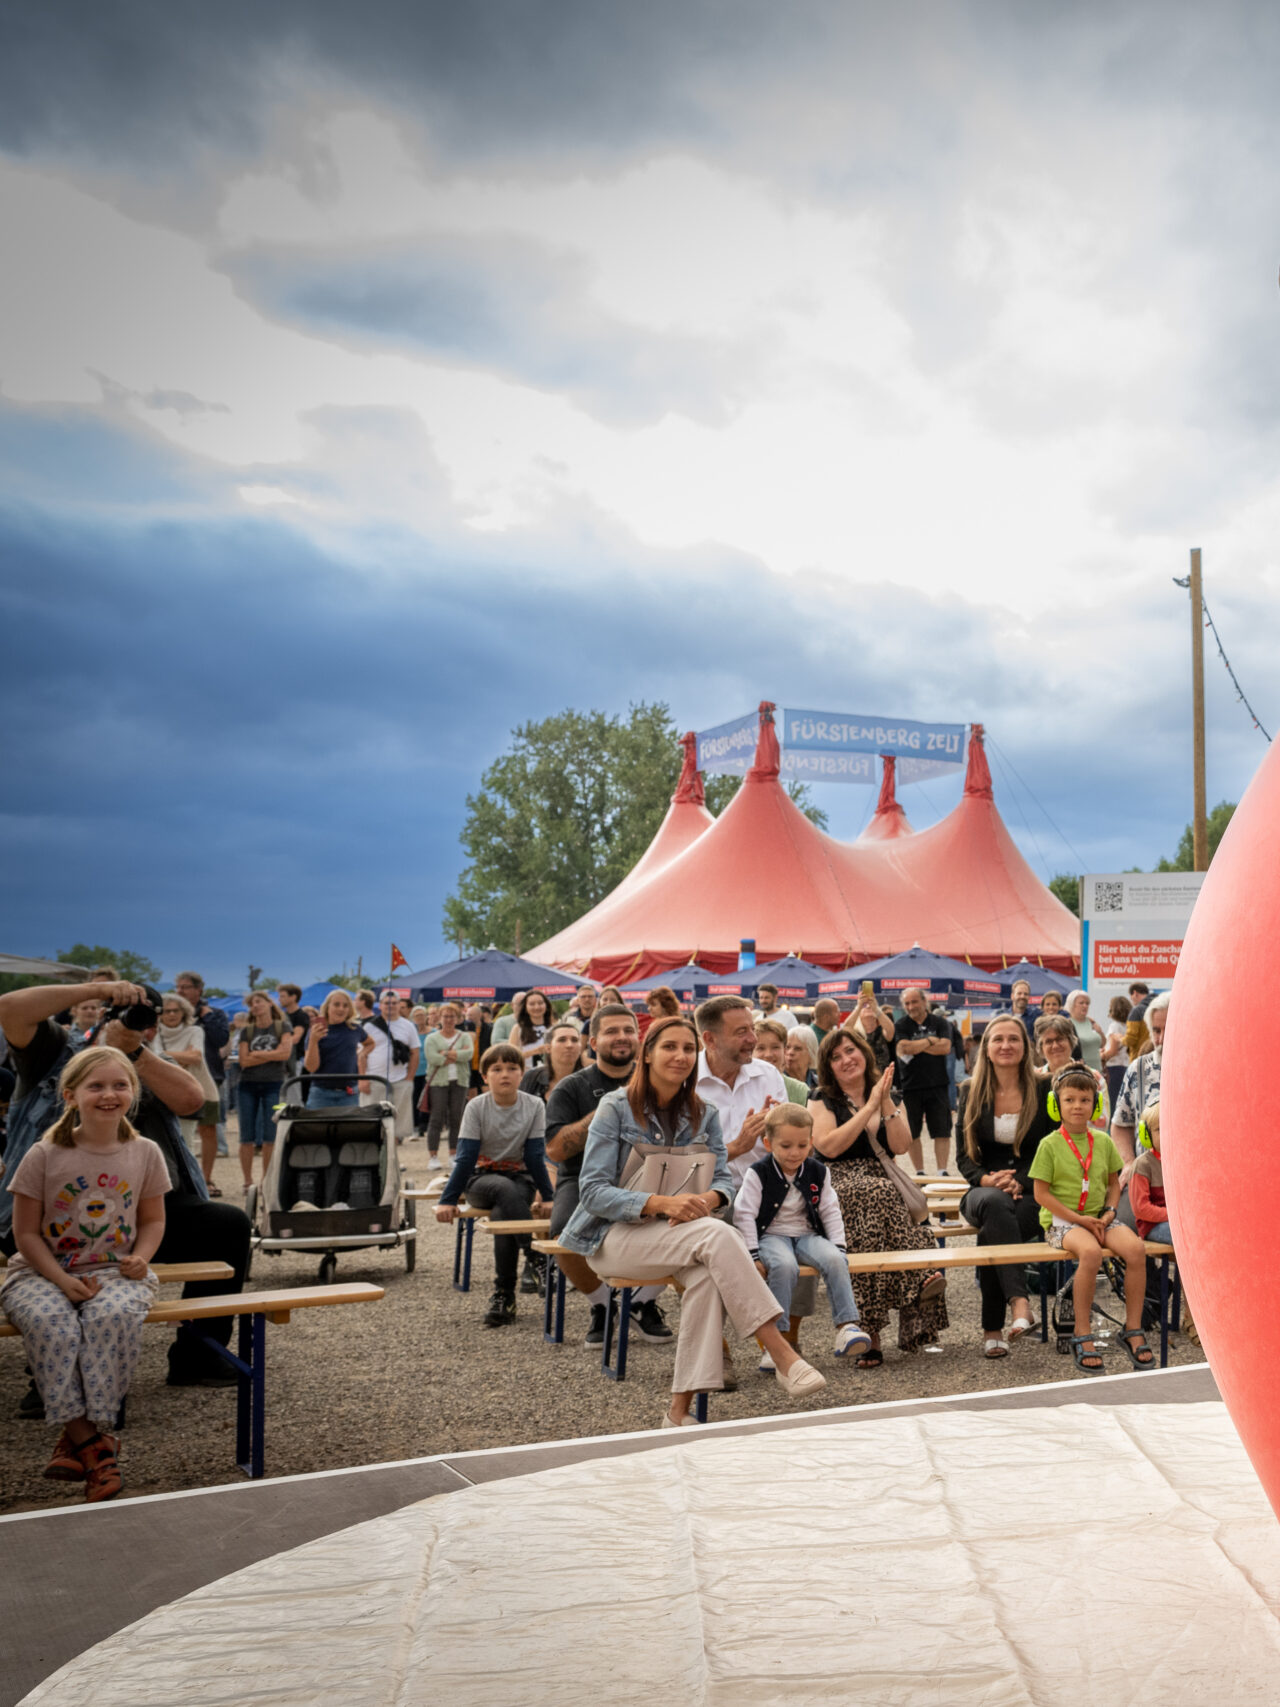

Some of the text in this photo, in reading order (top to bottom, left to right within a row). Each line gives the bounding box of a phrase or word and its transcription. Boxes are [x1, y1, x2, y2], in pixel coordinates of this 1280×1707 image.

[791, 718, 921, 750] FÜRSTENBERG
[926, 732, 961, 754] ZELT
[1098, 944, 1182, 954] Hier bist du Zuscha
[1098, 954, 1113, 964] bei
[1114, 956, 1131, 964] uns
[1131, 954, 1155, 964] wirst
[1156, 954, 1169, 964] du
[1098, 964, 1140, 975] (w/m/d).
[53, 1172, 133, 1211] HERE COMES
